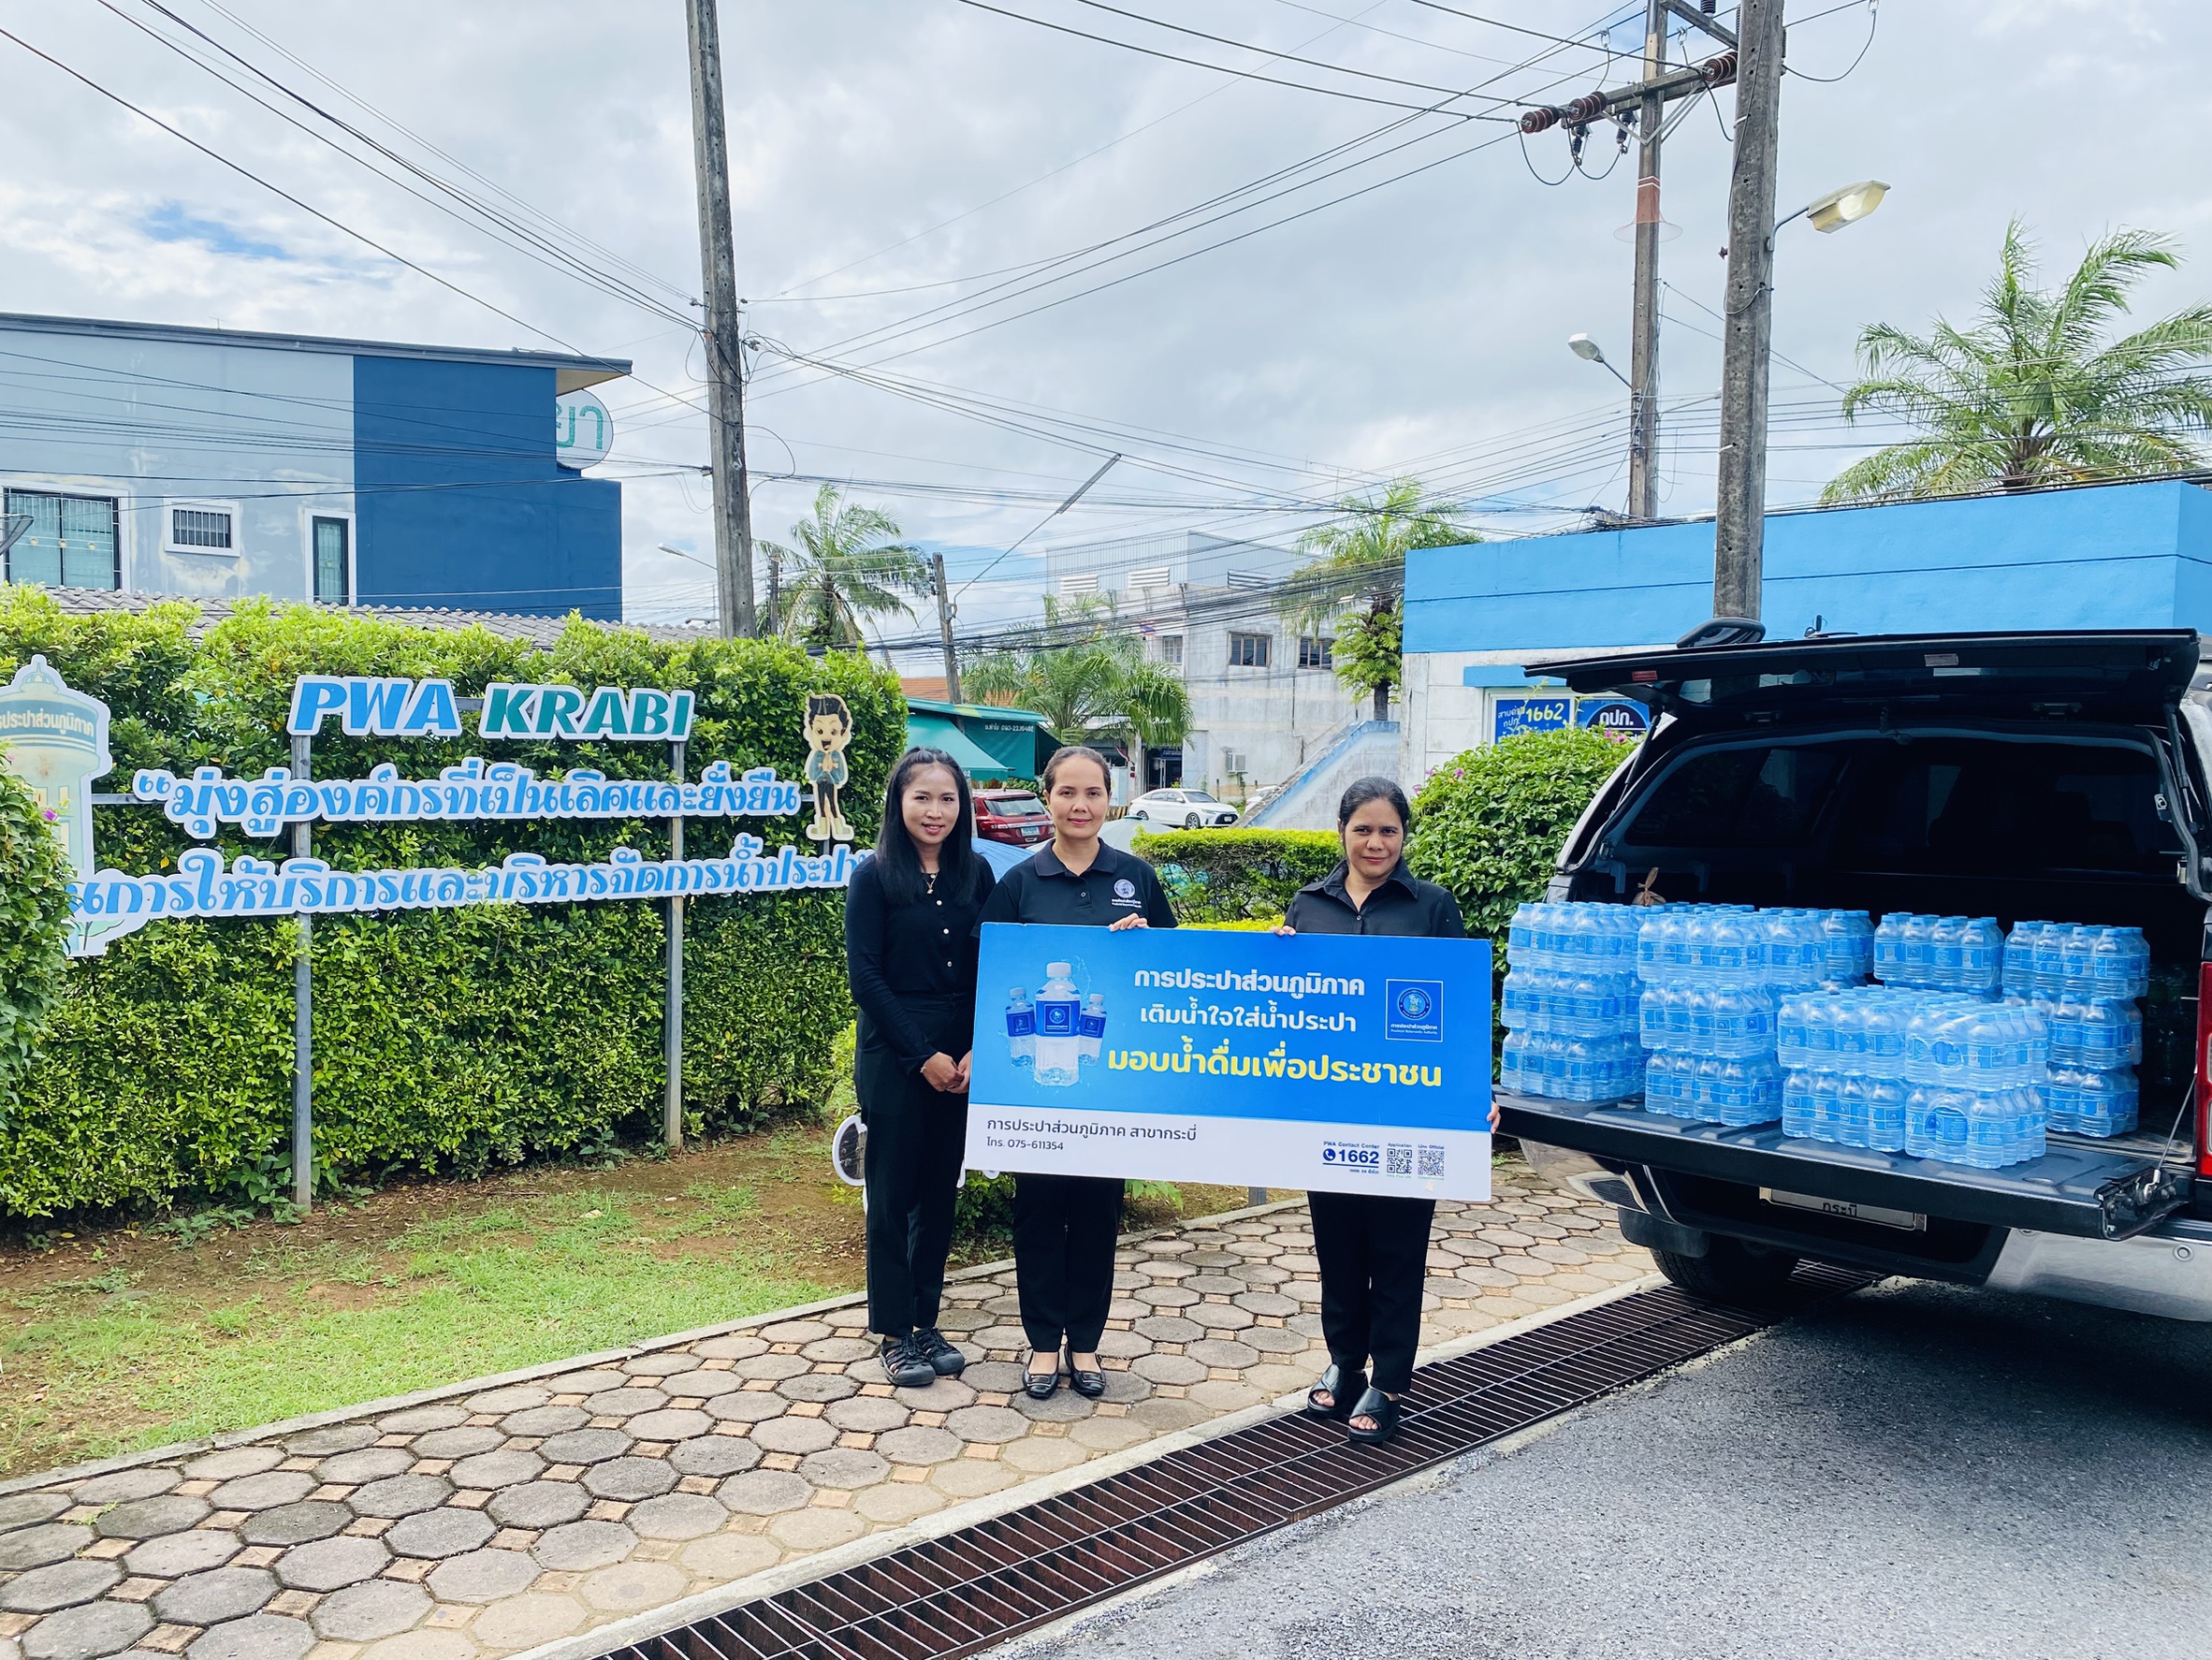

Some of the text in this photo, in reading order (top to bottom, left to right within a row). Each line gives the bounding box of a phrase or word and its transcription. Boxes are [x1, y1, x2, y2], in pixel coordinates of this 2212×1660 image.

[293, 681, 691, 736] PWA KRABI
[1525, 703, 1564, 722] 1662
[1599, 708, 1635, 726] กปภ.
[0, 707, 94, 737] ประปาส่วนภูมิภาค
[1134, 968, 1365, 999] การประปาส่วนภูมิภาค
[1140, 997, 1357, 1032] เติมน้ำใจใส่น้ำประปา
[1108, 1035, 1442, 1087] มอบน้ำดื่มเพื่อประชาชน
[987, 1118, 1197, 1141] การประปาส่วนภูมิภาค สาขากระบี่
[986, 1136, 1064, 1150] โทร. 075-611354
[1339, 1149, 1379, 1164] 1662
[1823, 1202, 1857, 1217] กระบี
